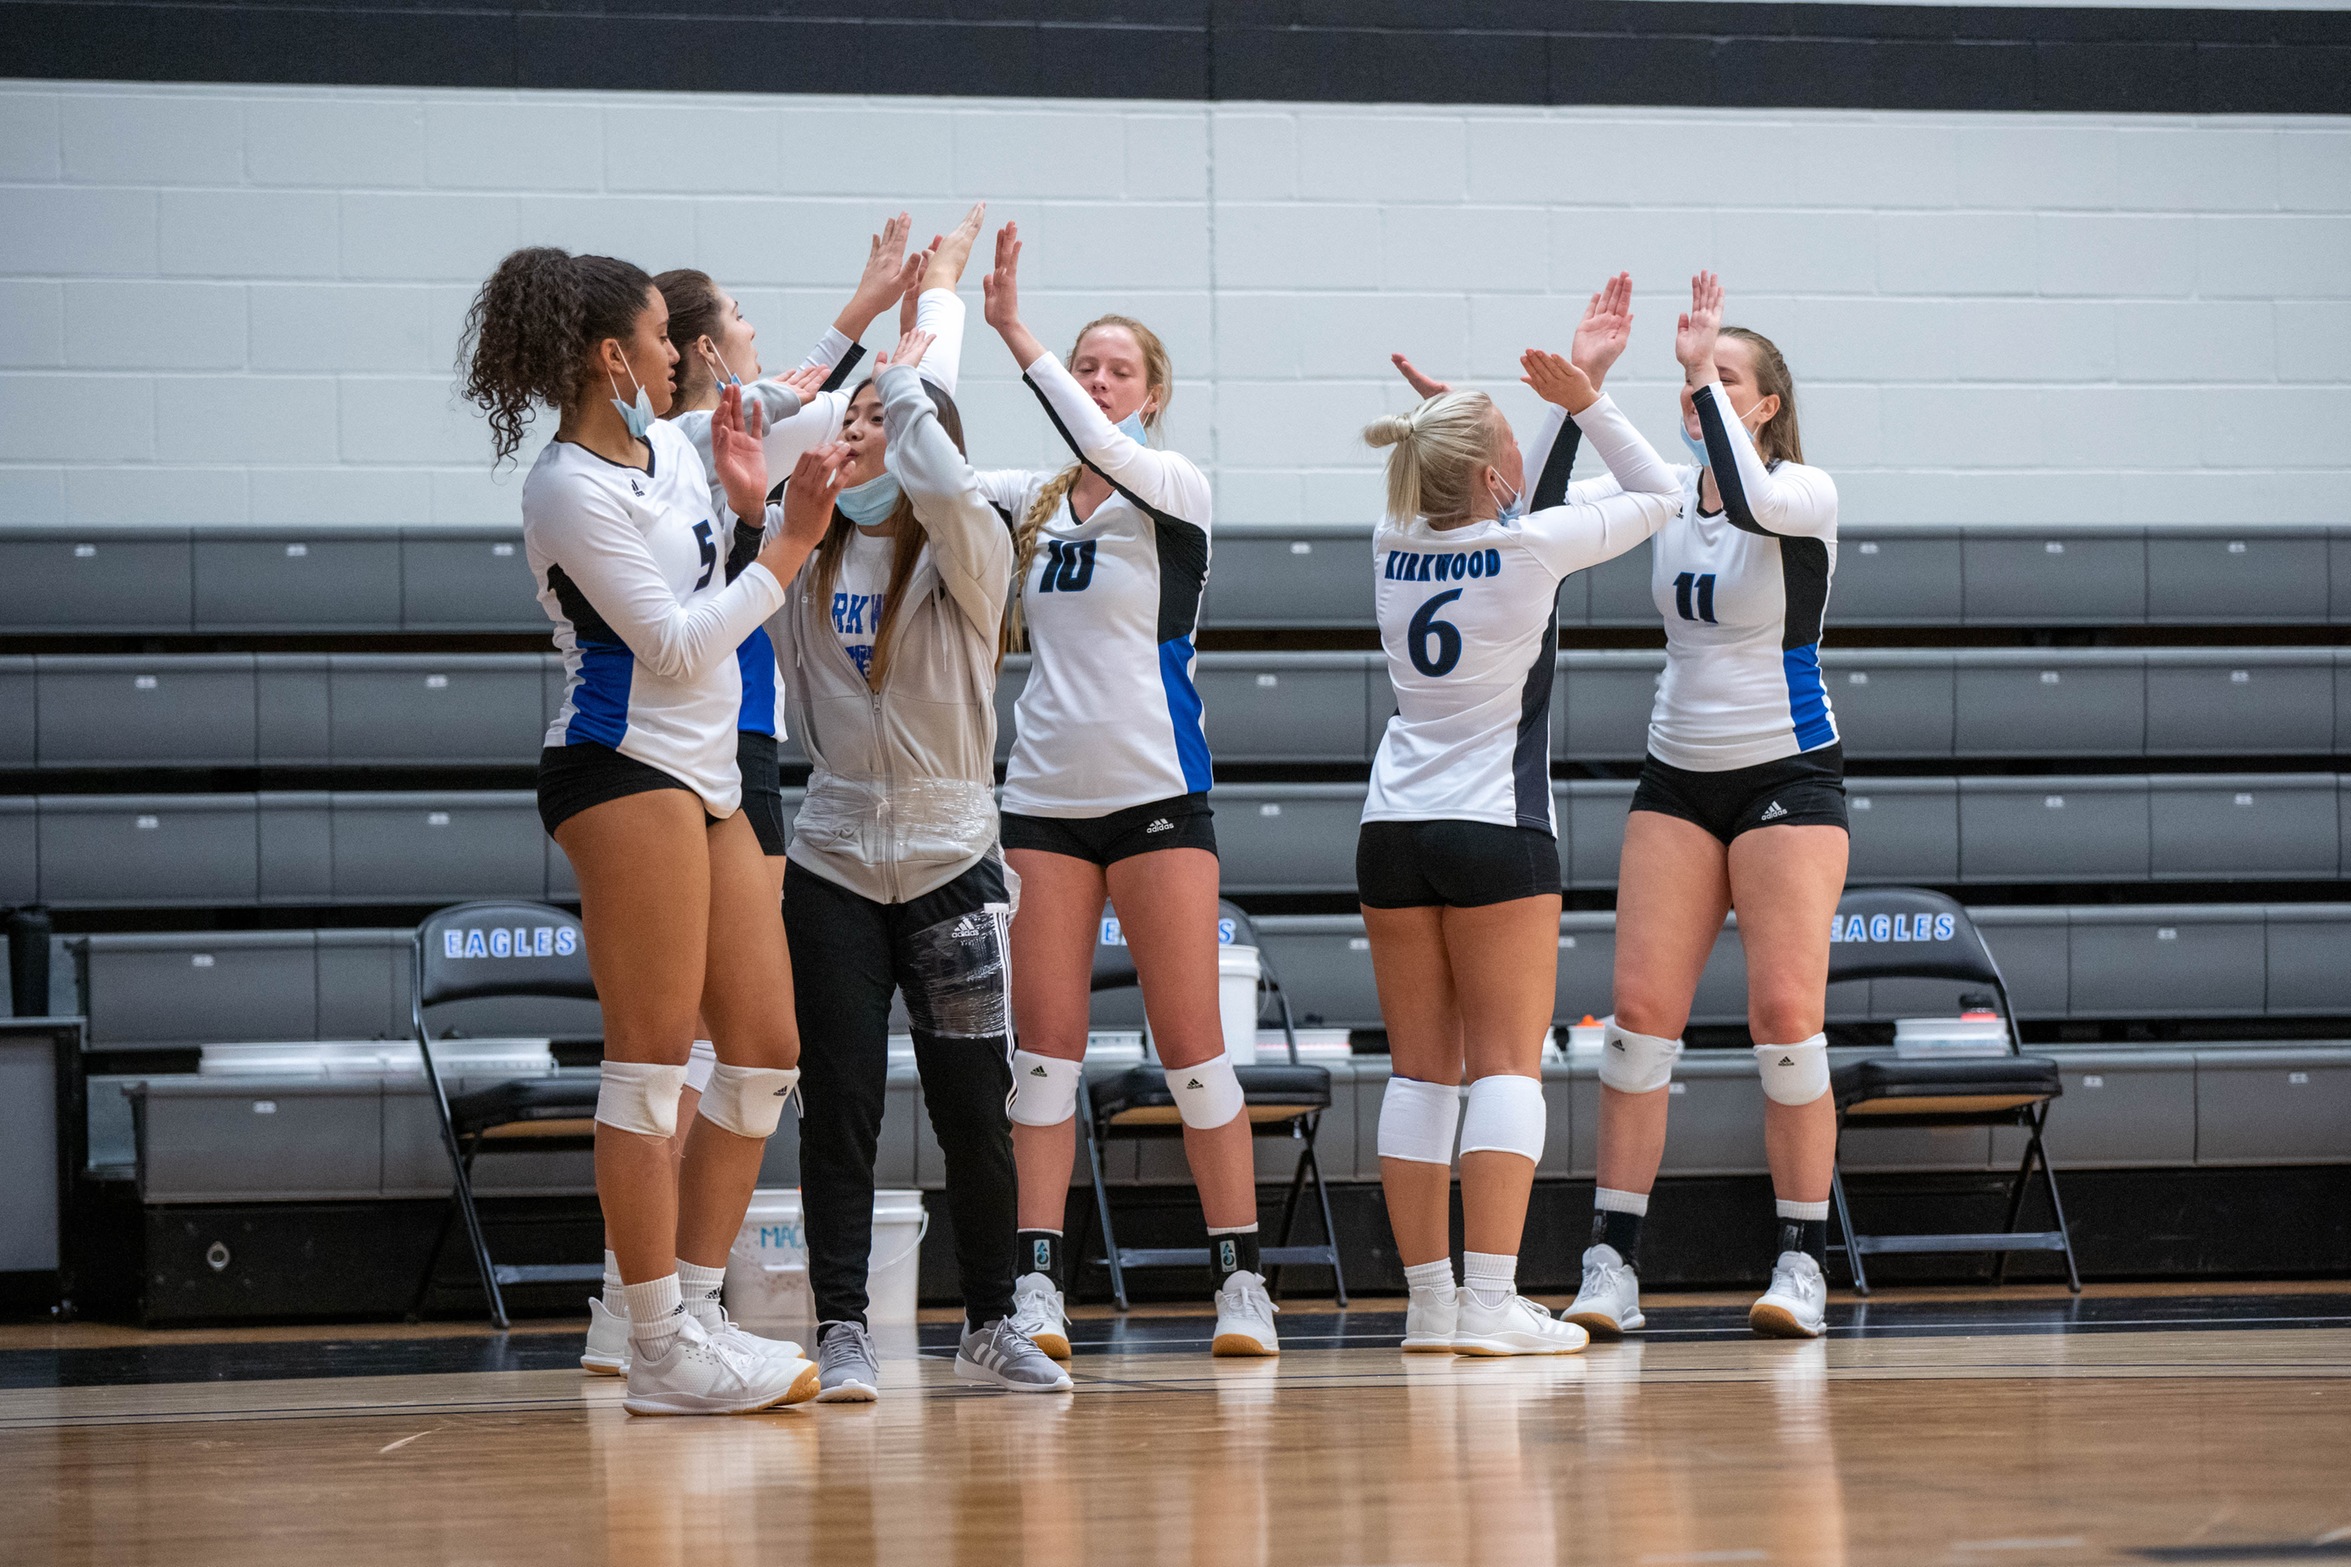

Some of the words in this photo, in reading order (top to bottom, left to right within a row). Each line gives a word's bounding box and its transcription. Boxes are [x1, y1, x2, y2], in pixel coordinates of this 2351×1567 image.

[692, 519, 717, 592] 5
[1039, 539, 1097, 593] 10
[1384, 548, 1501, 582] KIRKWOOD
[1673, 572, 1718, 624] 11
[1407, 588, 1463, 677] 6
[1146, 823, 1174, 834] adidas
[1761, 809, 1788, 821] adidas
[444, 926, 577, 958] EAGLES
[951, 930, 980, 938] adidas
